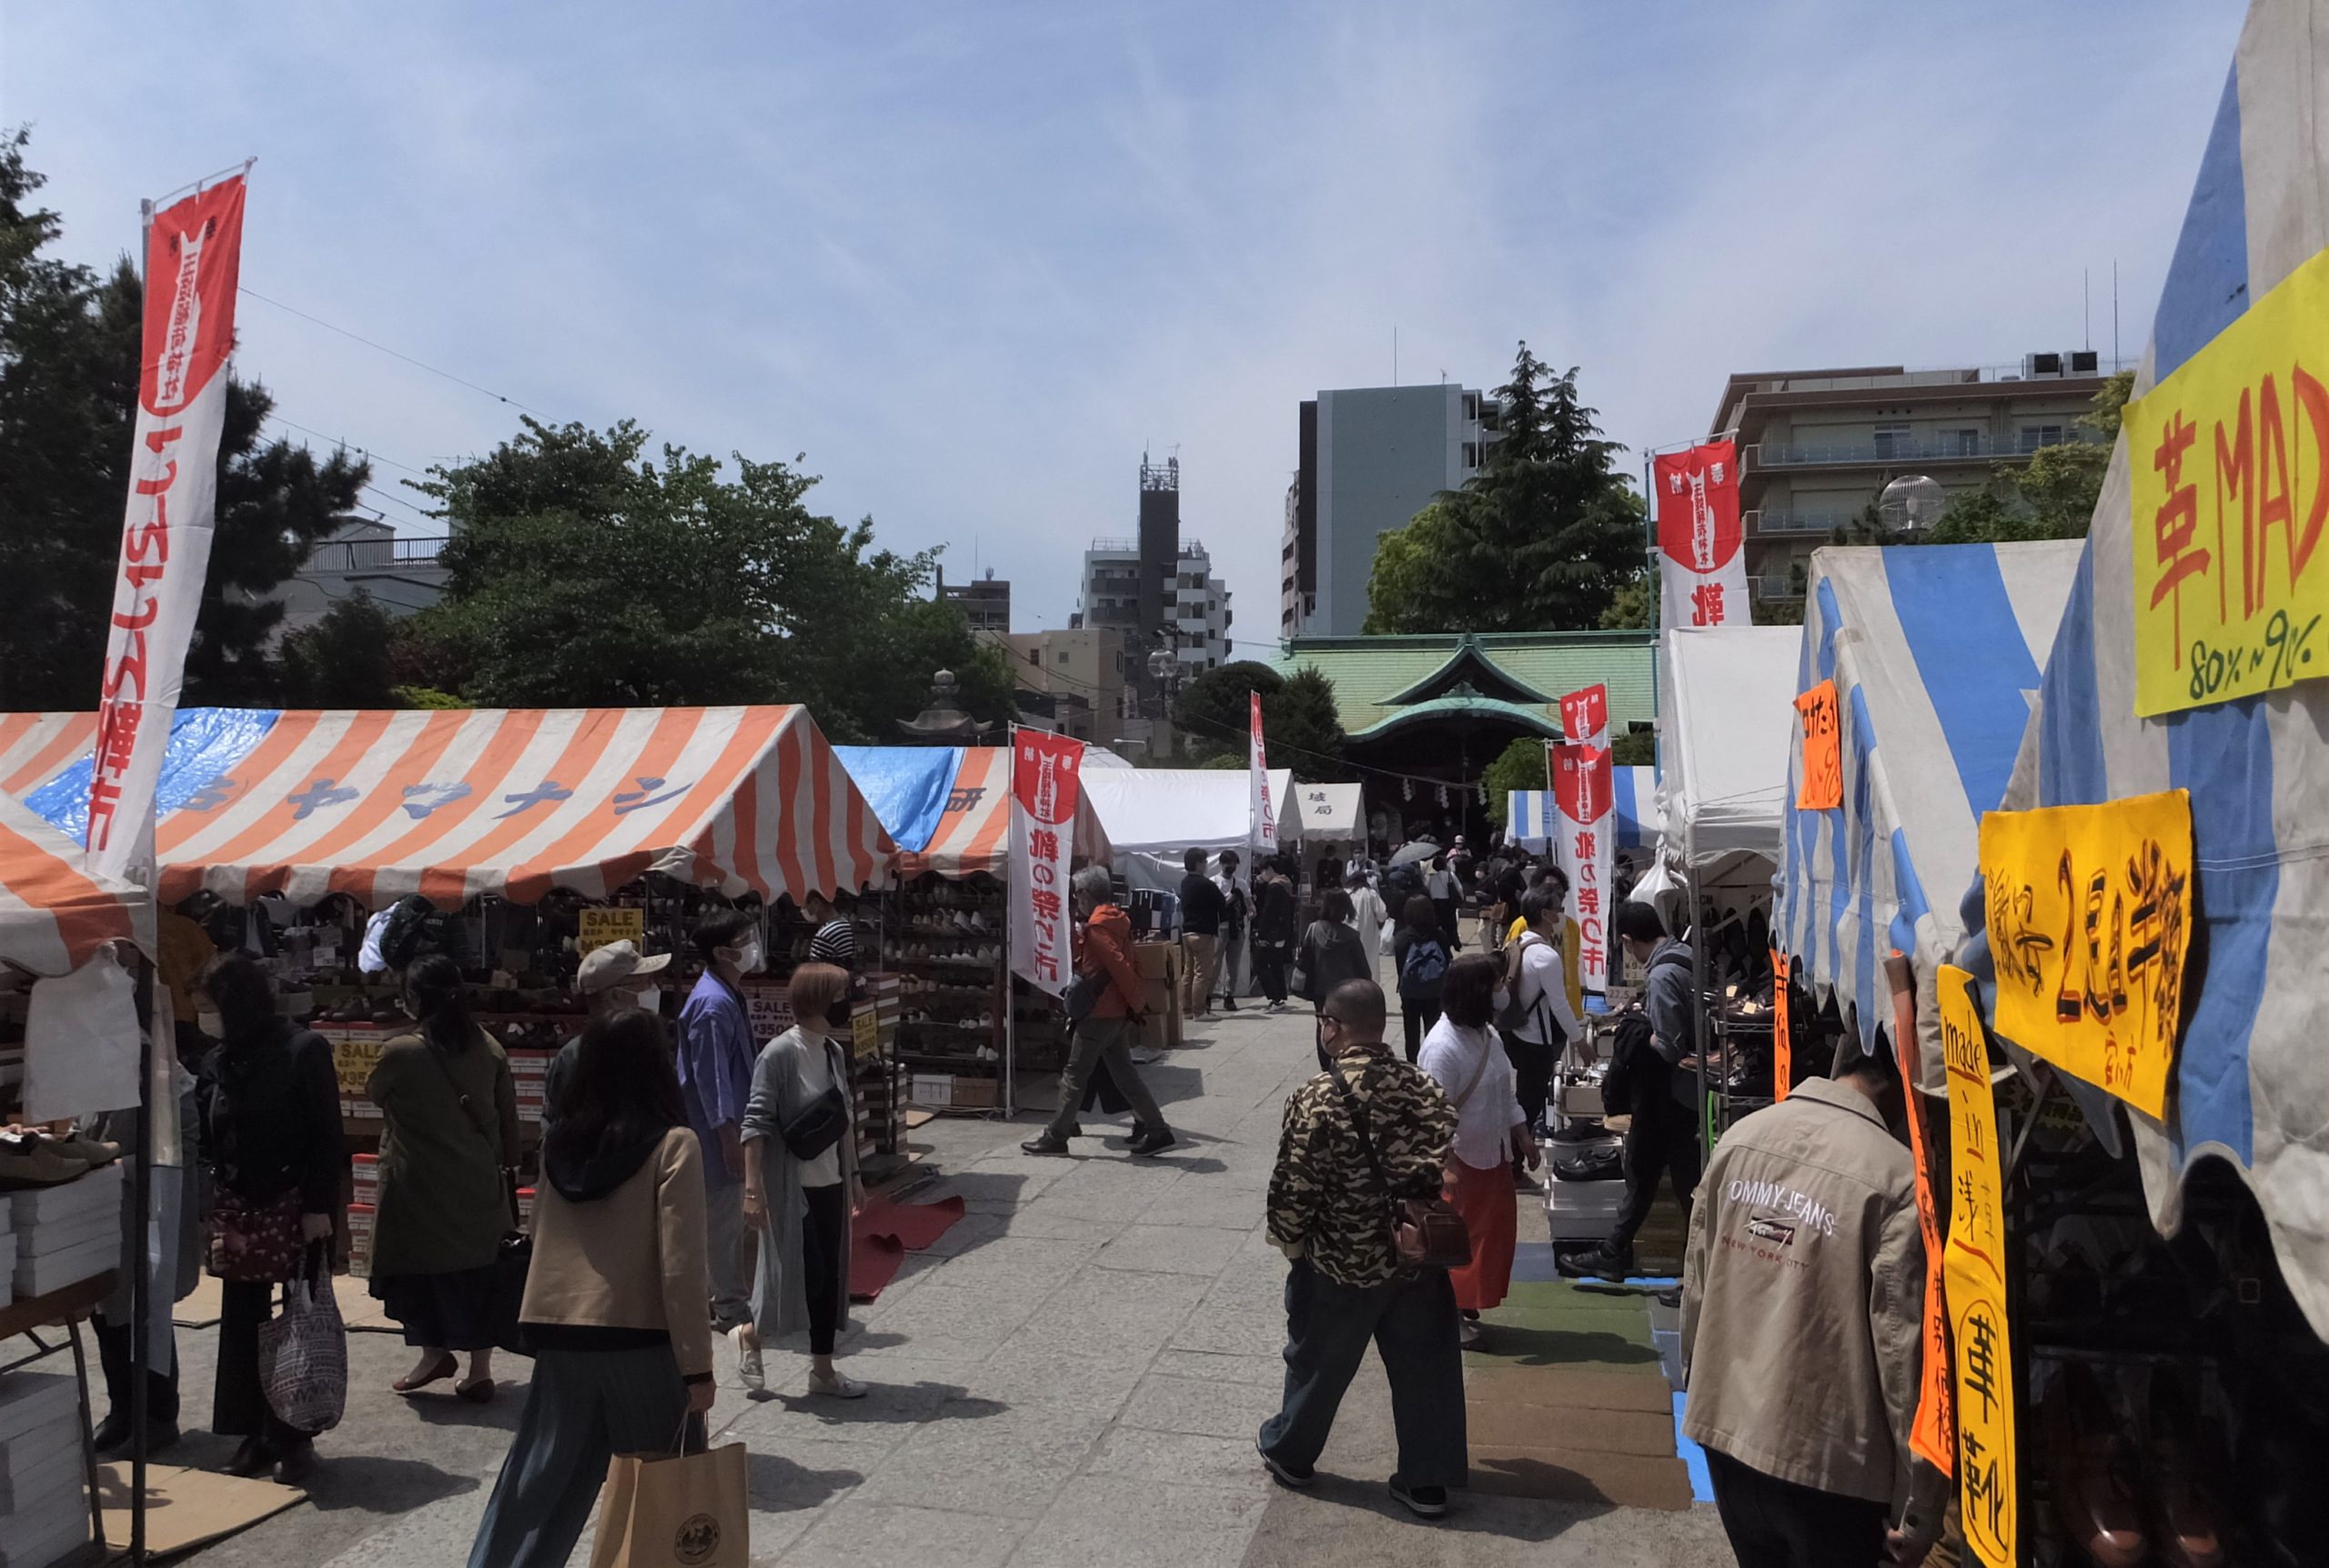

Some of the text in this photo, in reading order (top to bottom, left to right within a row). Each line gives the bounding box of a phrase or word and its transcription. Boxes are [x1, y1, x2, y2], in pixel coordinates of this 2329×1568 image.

[586, 911, 634, 926] SALE
[752, 1001, 791, 1013] SALE
[1944, 1010, 1984, 1079] made
[1961, 1090, 1984, 1154] in
[1729, 1181, 1836, 1236] OMMY JEANS
[1722, 1235, 1810, 1272] NEW YORK CITY
[1962, 1314, 2008, 1552] 革靴
